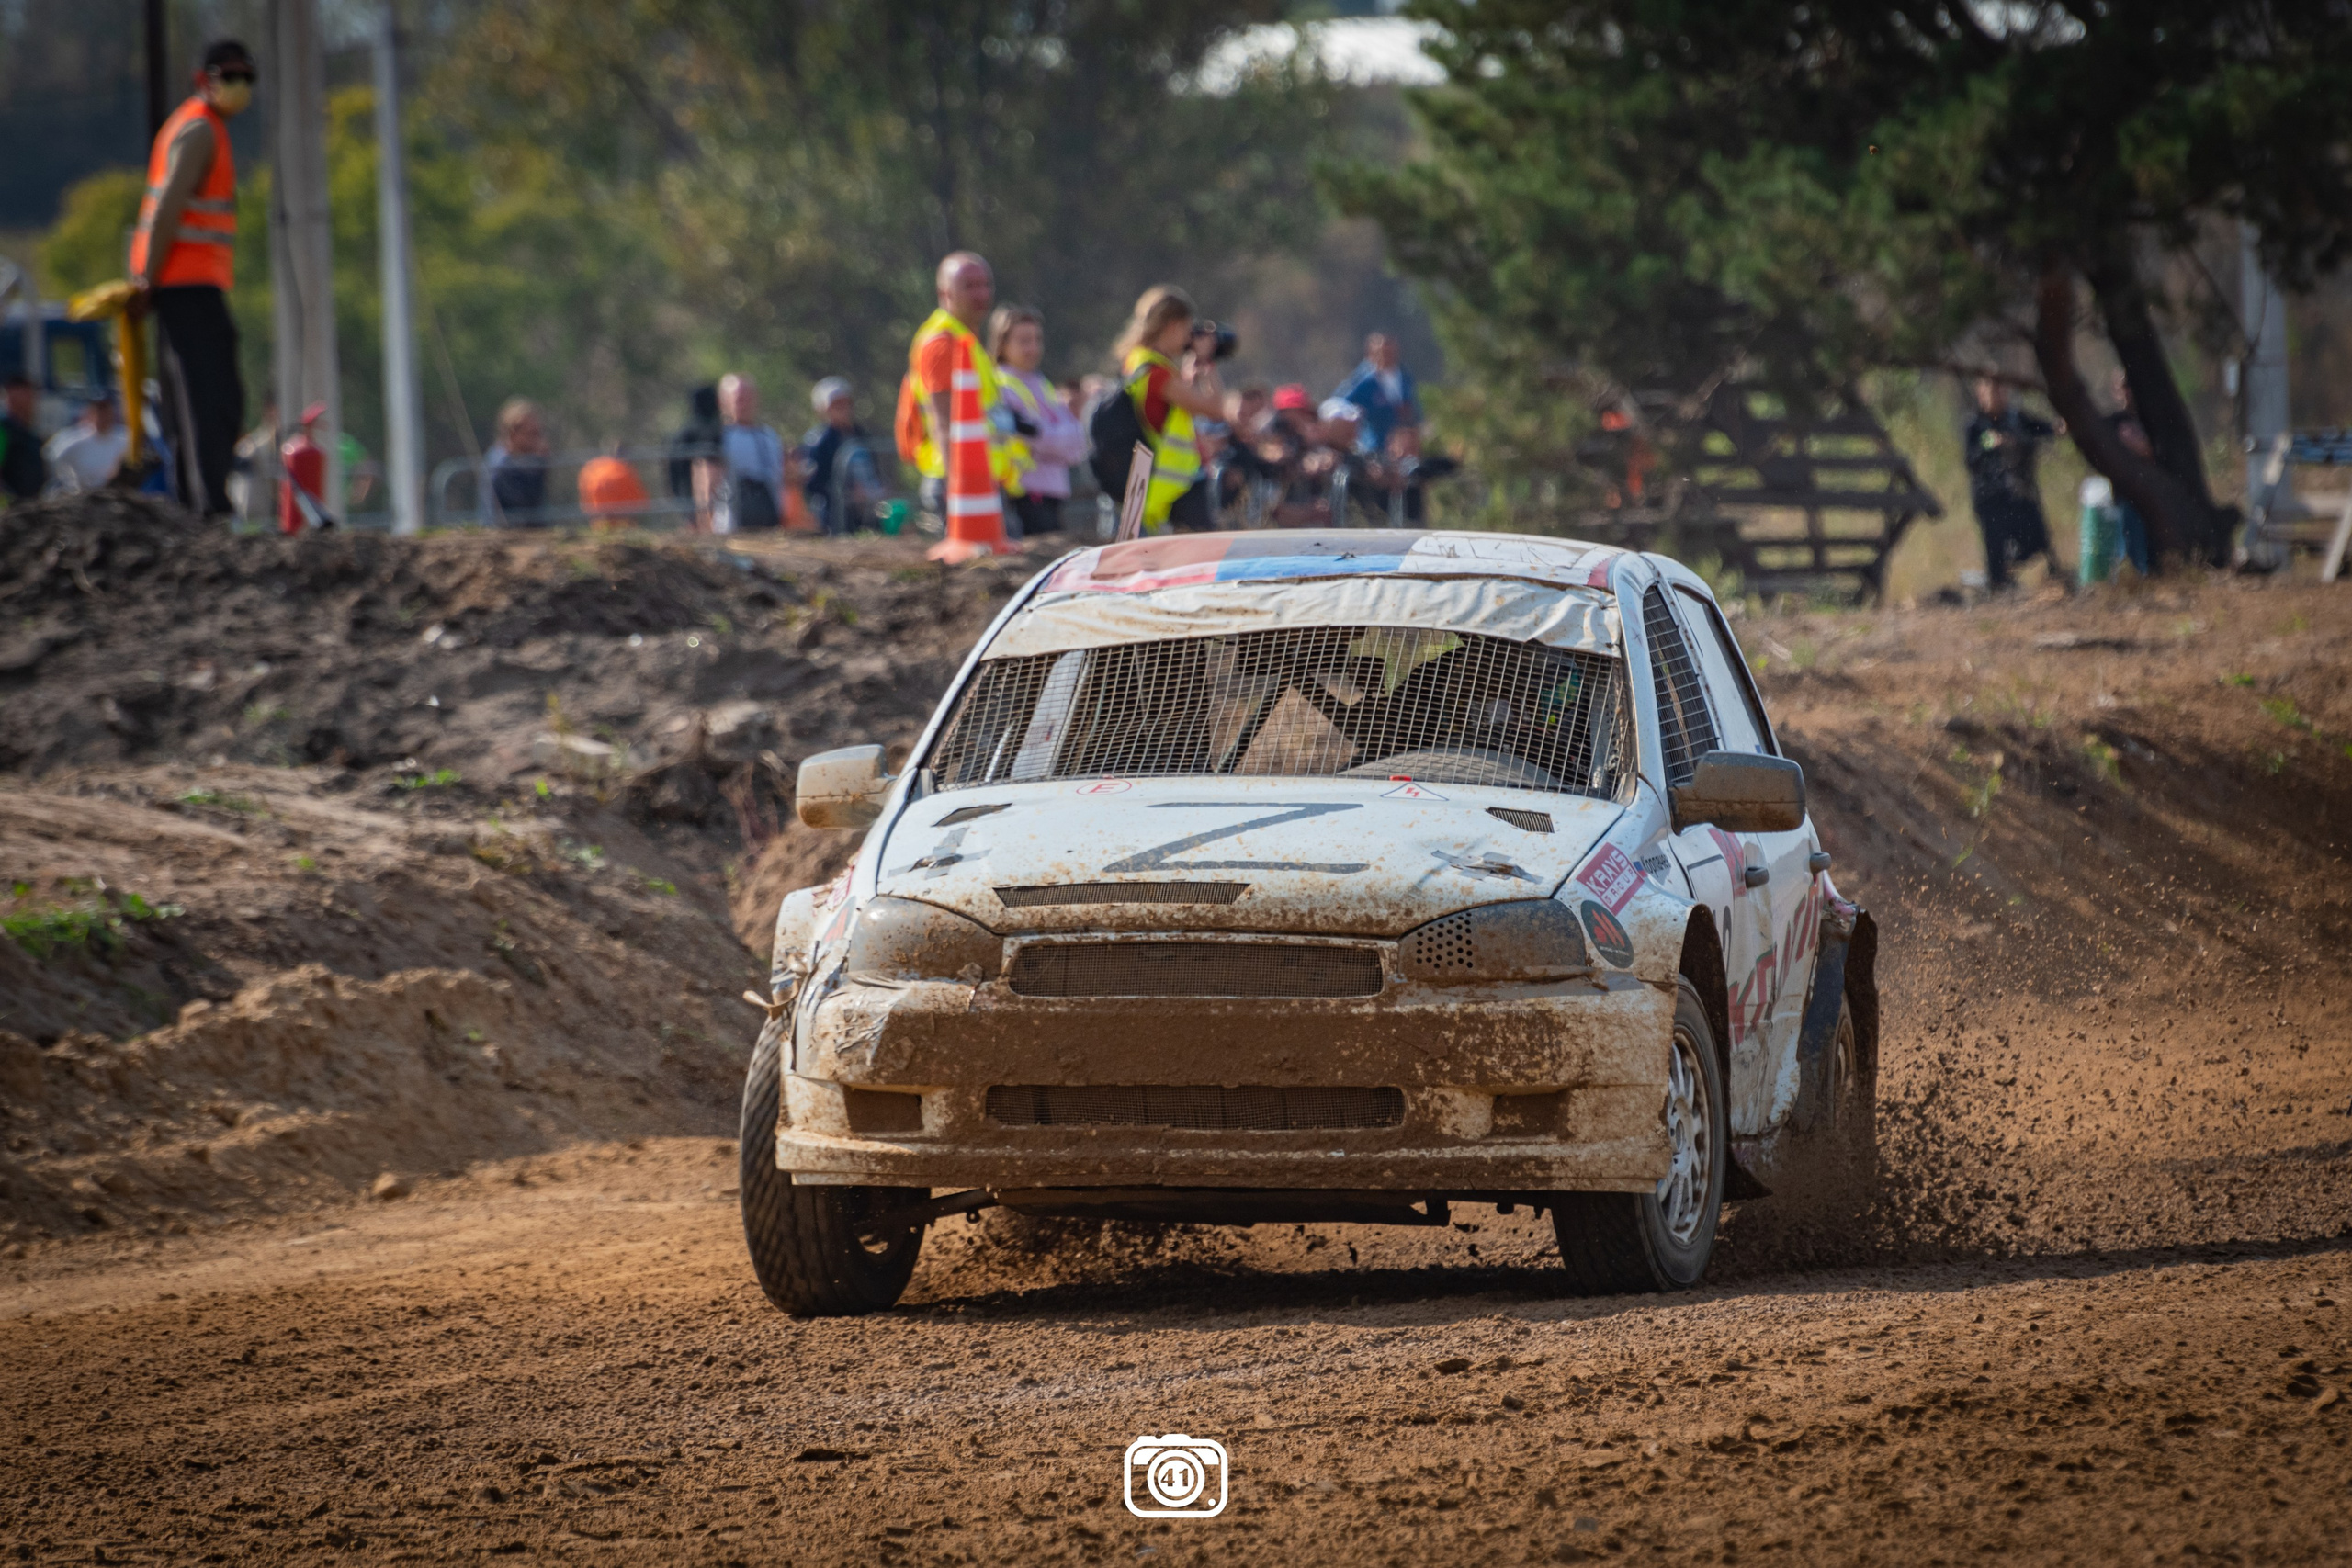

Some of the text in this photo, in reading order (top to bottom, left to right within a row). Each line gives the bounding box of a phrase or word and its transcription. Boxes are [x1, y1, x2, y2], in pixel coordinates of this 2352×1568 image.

[1088, 783, 1121, 794] E
[1102, 802, 1371, 874] Z
[1585, 849, 1629, 897] KRAYS
[1603, 867, 1634, 906] GROUP
